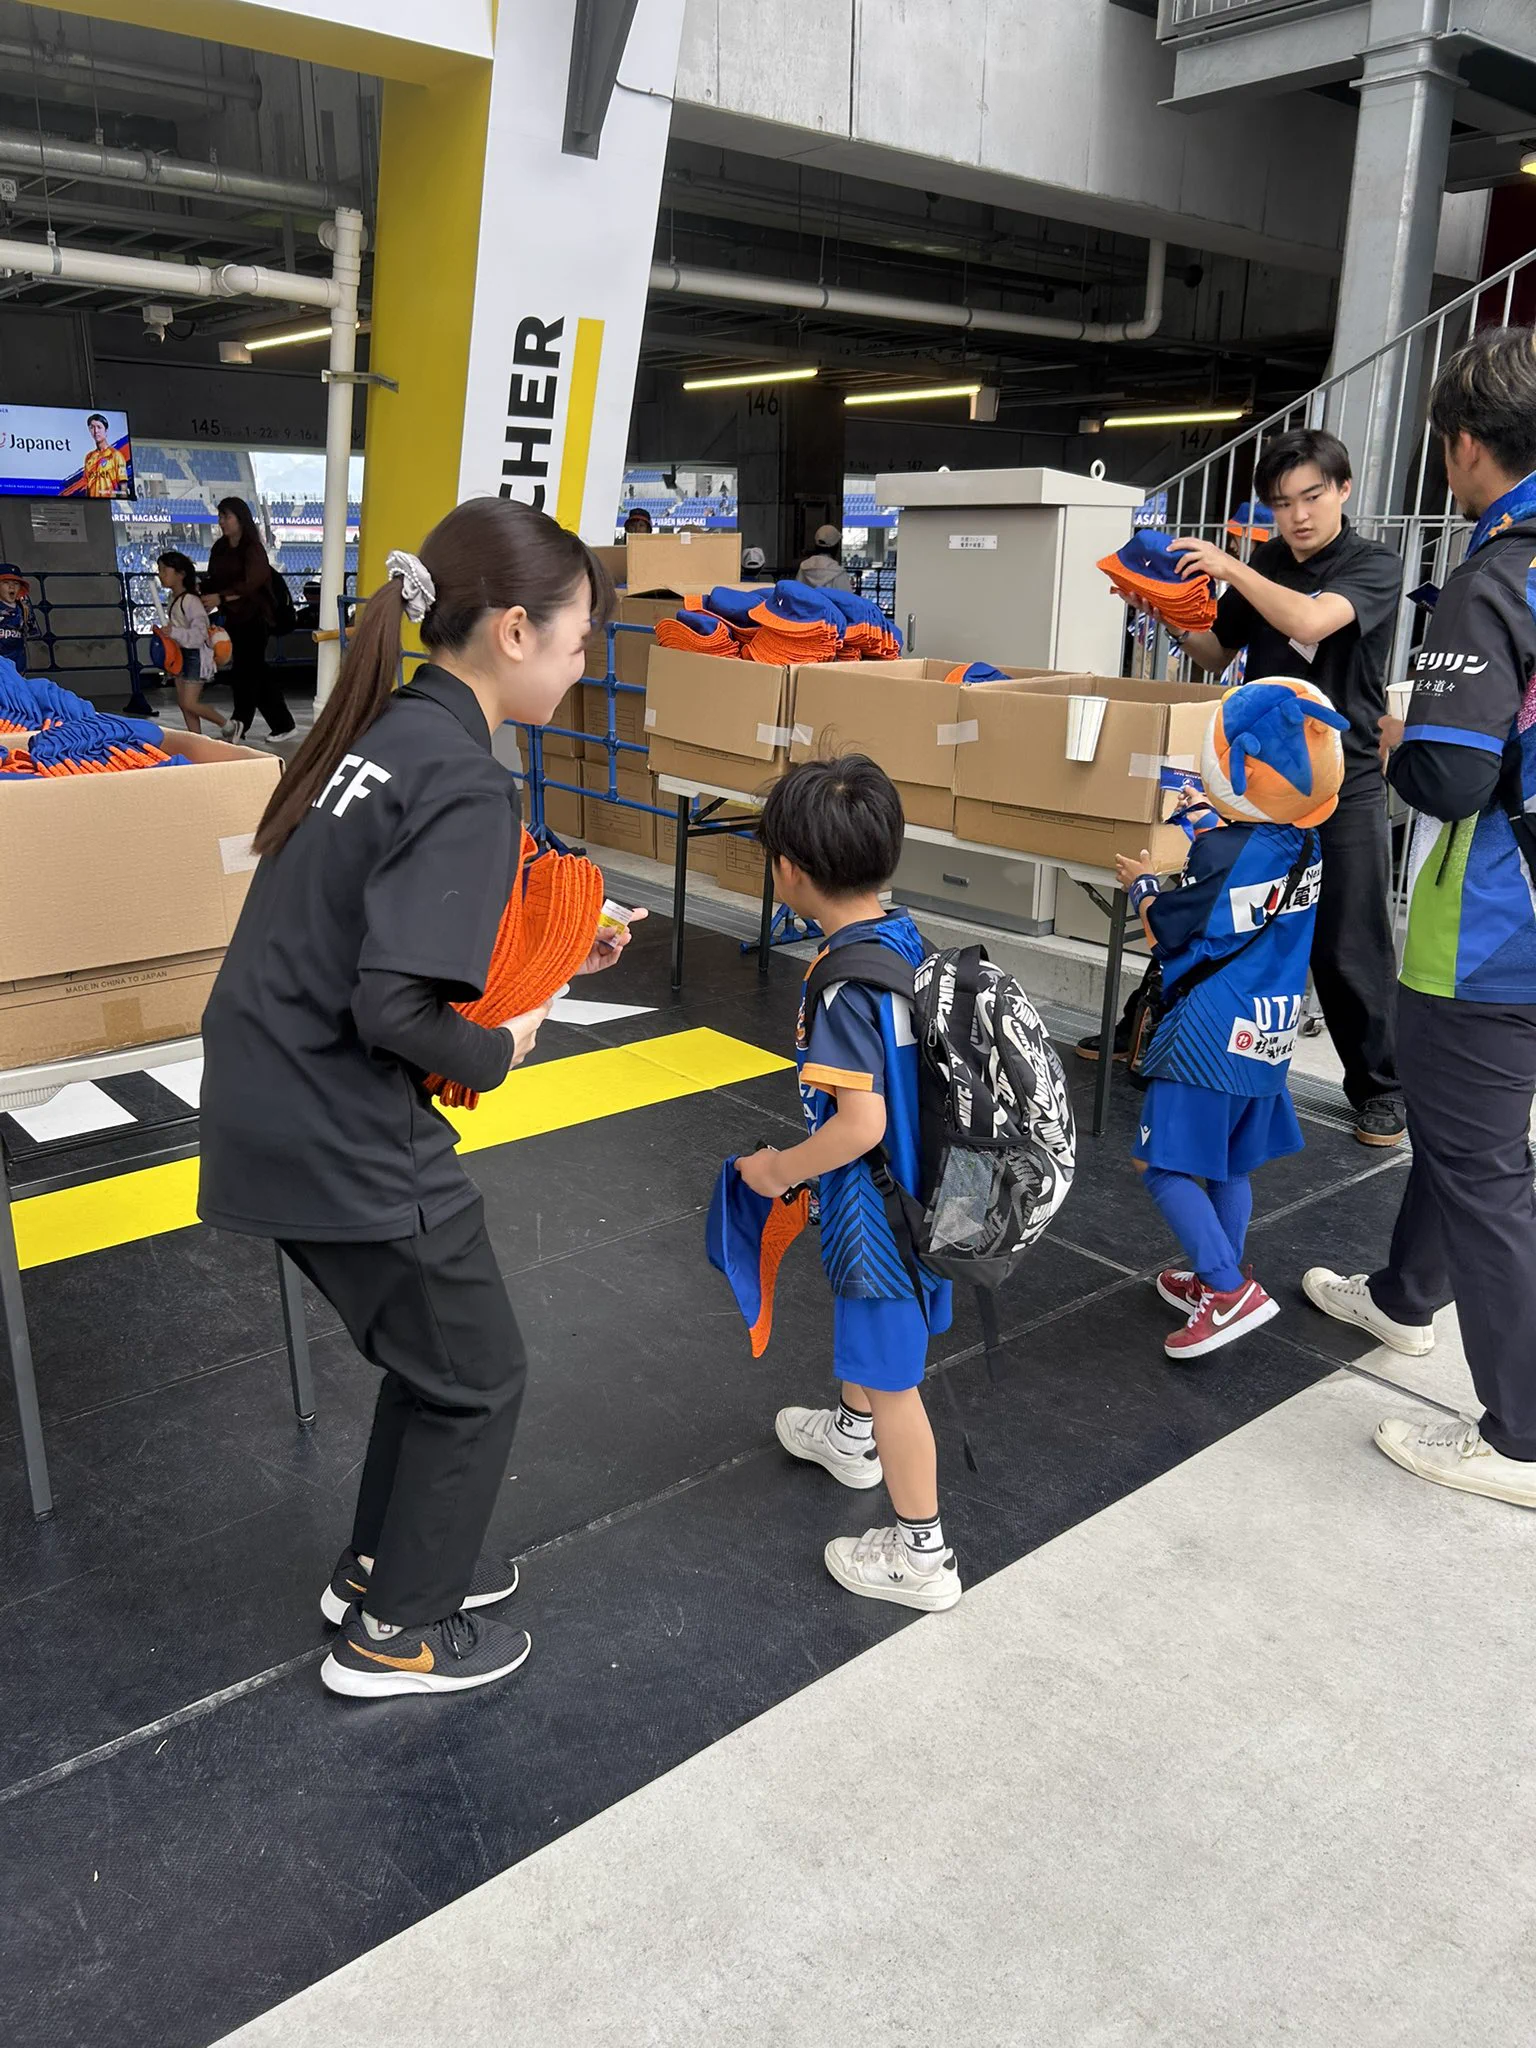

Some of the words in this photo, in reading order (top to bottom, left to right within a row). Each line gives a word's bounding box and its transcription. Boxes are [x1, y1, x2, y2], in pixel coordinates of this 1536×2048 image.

[746, 388, 779, 416] 146
[191, 418, 221, 436] 145
[9, 433, 72, 453] Japanet
[1181, 428, 1213, 450] 147
[132, 514, 172, 523] NAGASAKI
[285, 516, 323, 525] NAGASAKI
[1134, 513, 1167, 525] ASAKI
[311, 753, 393, 818] FF
[65, 983, 90, 995] MADE
[90, 981, 100, 990] IN
[100, 978, 127, 989] CHINA
[128, 975, 140, 984] TO
[140, 970, 168, 982] JAPAN
[956, 1085, 973, 1129] NIKE
[1037, 1120, 1069, 1151] NIKE
[837, 1412, 854, 1431] P
[911, 1530, 932, 1548] P
